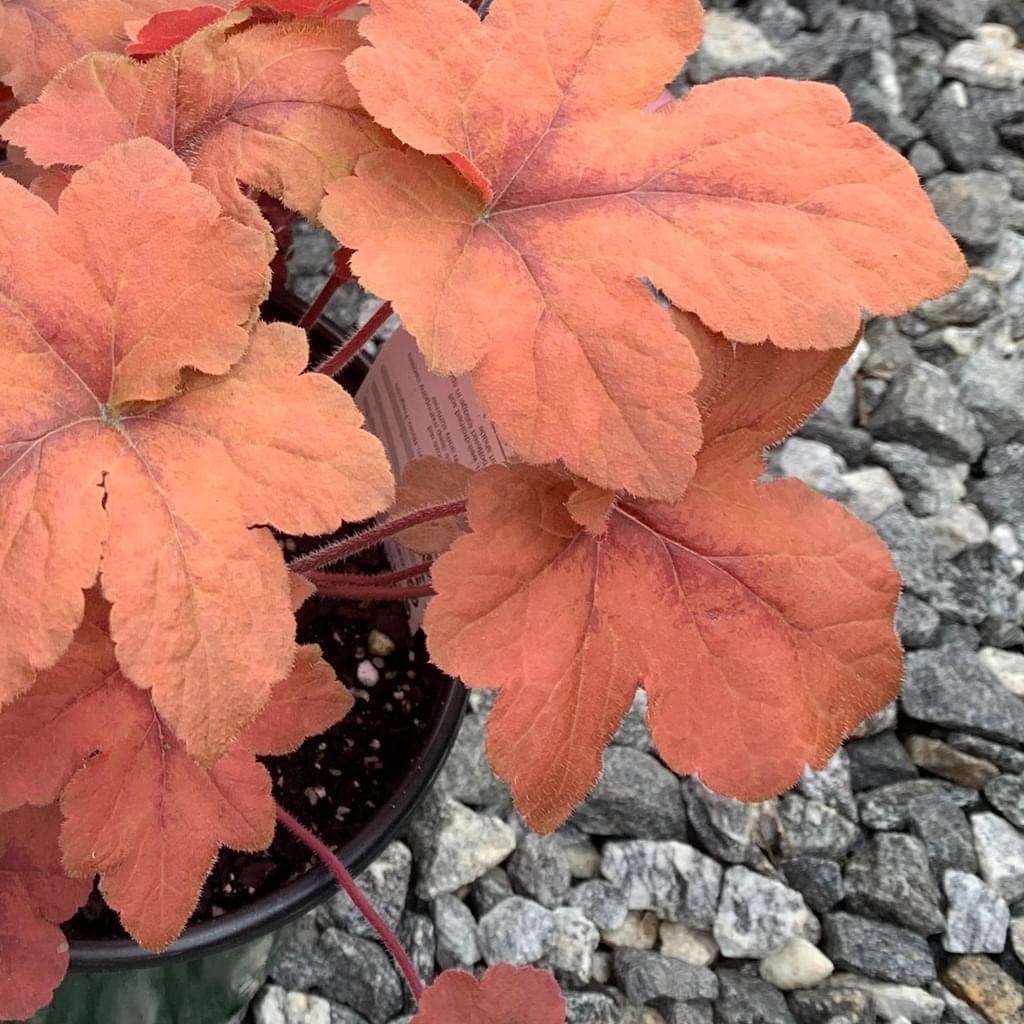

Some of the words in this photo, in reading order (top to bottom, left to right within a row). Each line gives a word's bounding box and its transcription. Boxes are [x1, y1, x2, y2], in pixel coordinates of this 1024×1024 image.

[418, 382, 439, 429] mahogany
[430, 395, 447, 431] summer
[447, 392, 457, 409] soil
[458, 396, 474, 430] foliage
[454, 408, 478, 463] well-drained
